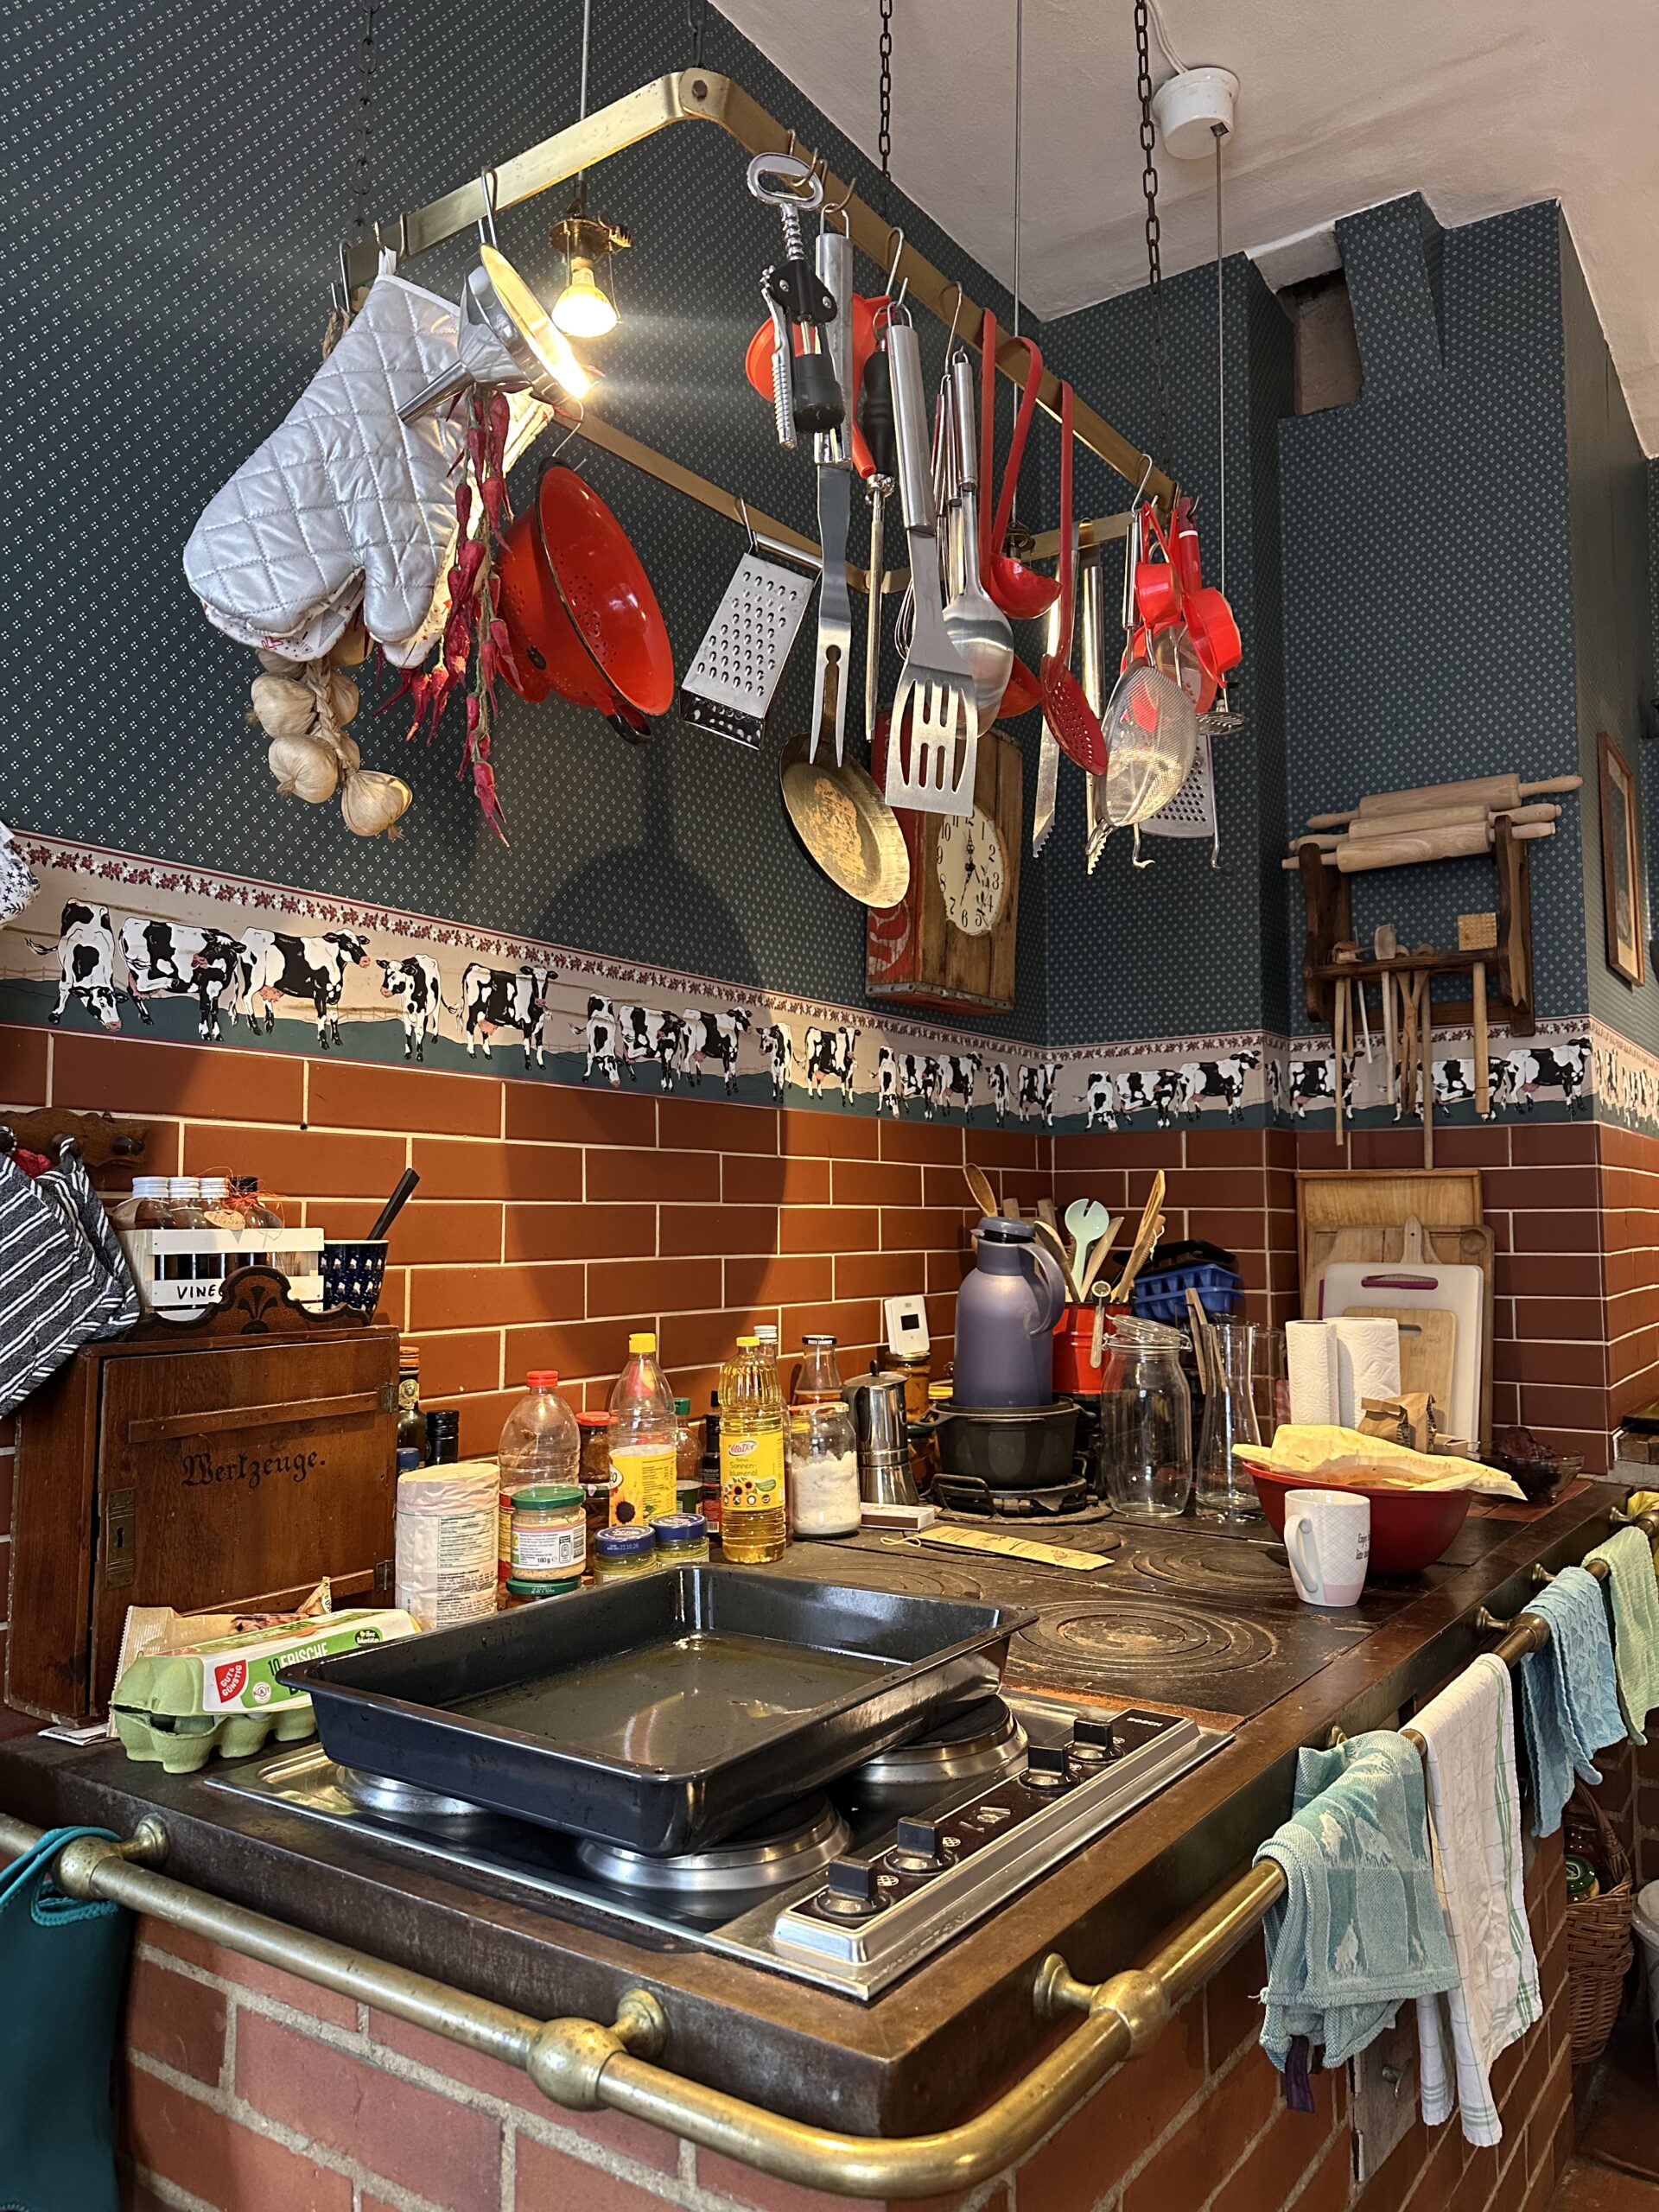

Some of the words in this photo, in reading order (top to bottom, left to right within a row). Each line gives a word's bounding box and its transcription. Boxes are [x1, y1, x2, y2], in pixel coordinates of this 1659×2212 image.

[941, 822, 951, 842] 10
[981, 821, 985, 840] 1
[936, 845, 944, 865] 9
[988, 844, 996, 862] 2
[939, 873, 947, 893] 8
[991, 871, 1000, 890] 3
[950, 896, 956, 915] 7
[987, 894, 994, 912] 4
[961, 909, 968, 928] 6
[976, 907, 986, 927] 5
[1126, 1717, 1164, 1727] BOSCH
